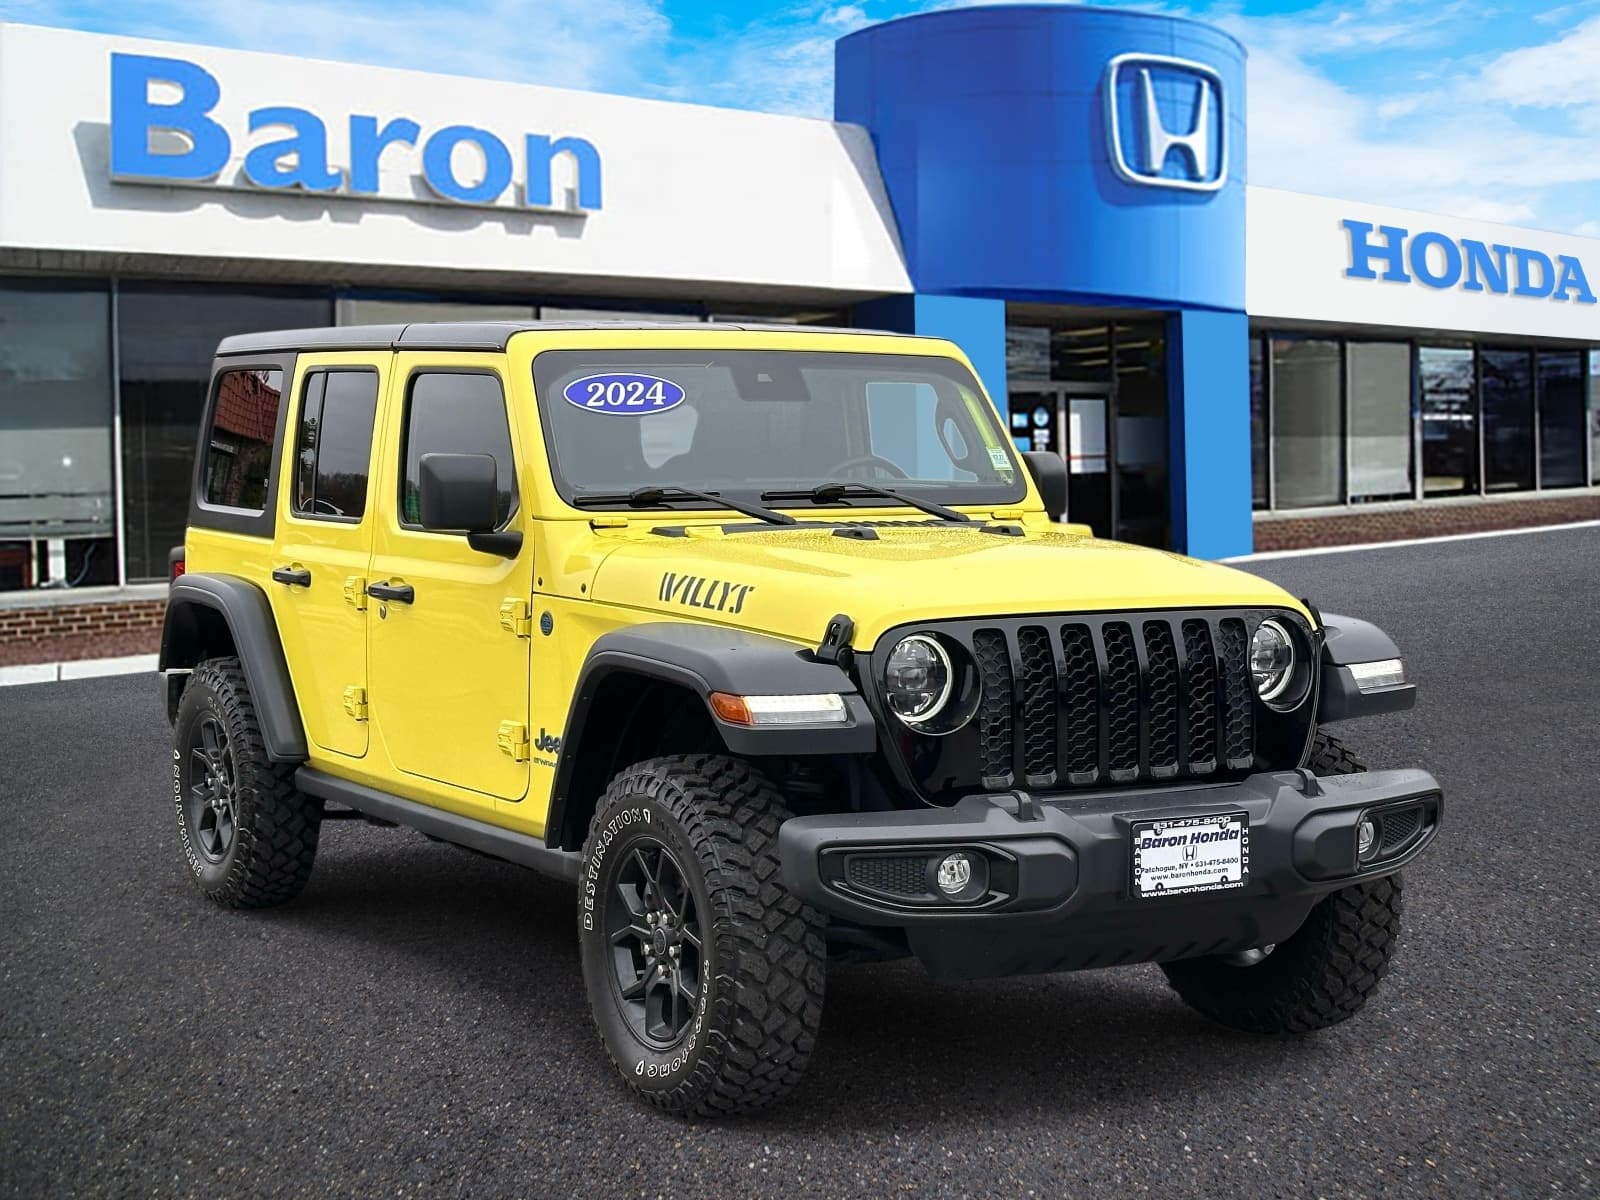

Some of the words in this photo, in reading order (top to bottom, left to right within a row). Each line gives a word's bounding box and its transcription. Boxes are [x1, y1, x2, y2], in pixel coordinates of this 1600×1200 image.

[111, 52, 602, 210] Baron
[1342, 219, 1597, 304] HONDA
[586, 381, 666, 406] 2024
[659, 572, 755, 614] WILLYS
[535, 727, 560, 753] Jee
[1141, 835, 1187, 849] Baron
[1190, 828, 1239, 844] Honda
[584, 810, 641, 931] DESTINATION
[1141, 882, 1243, 897] www.baronhonda.com
